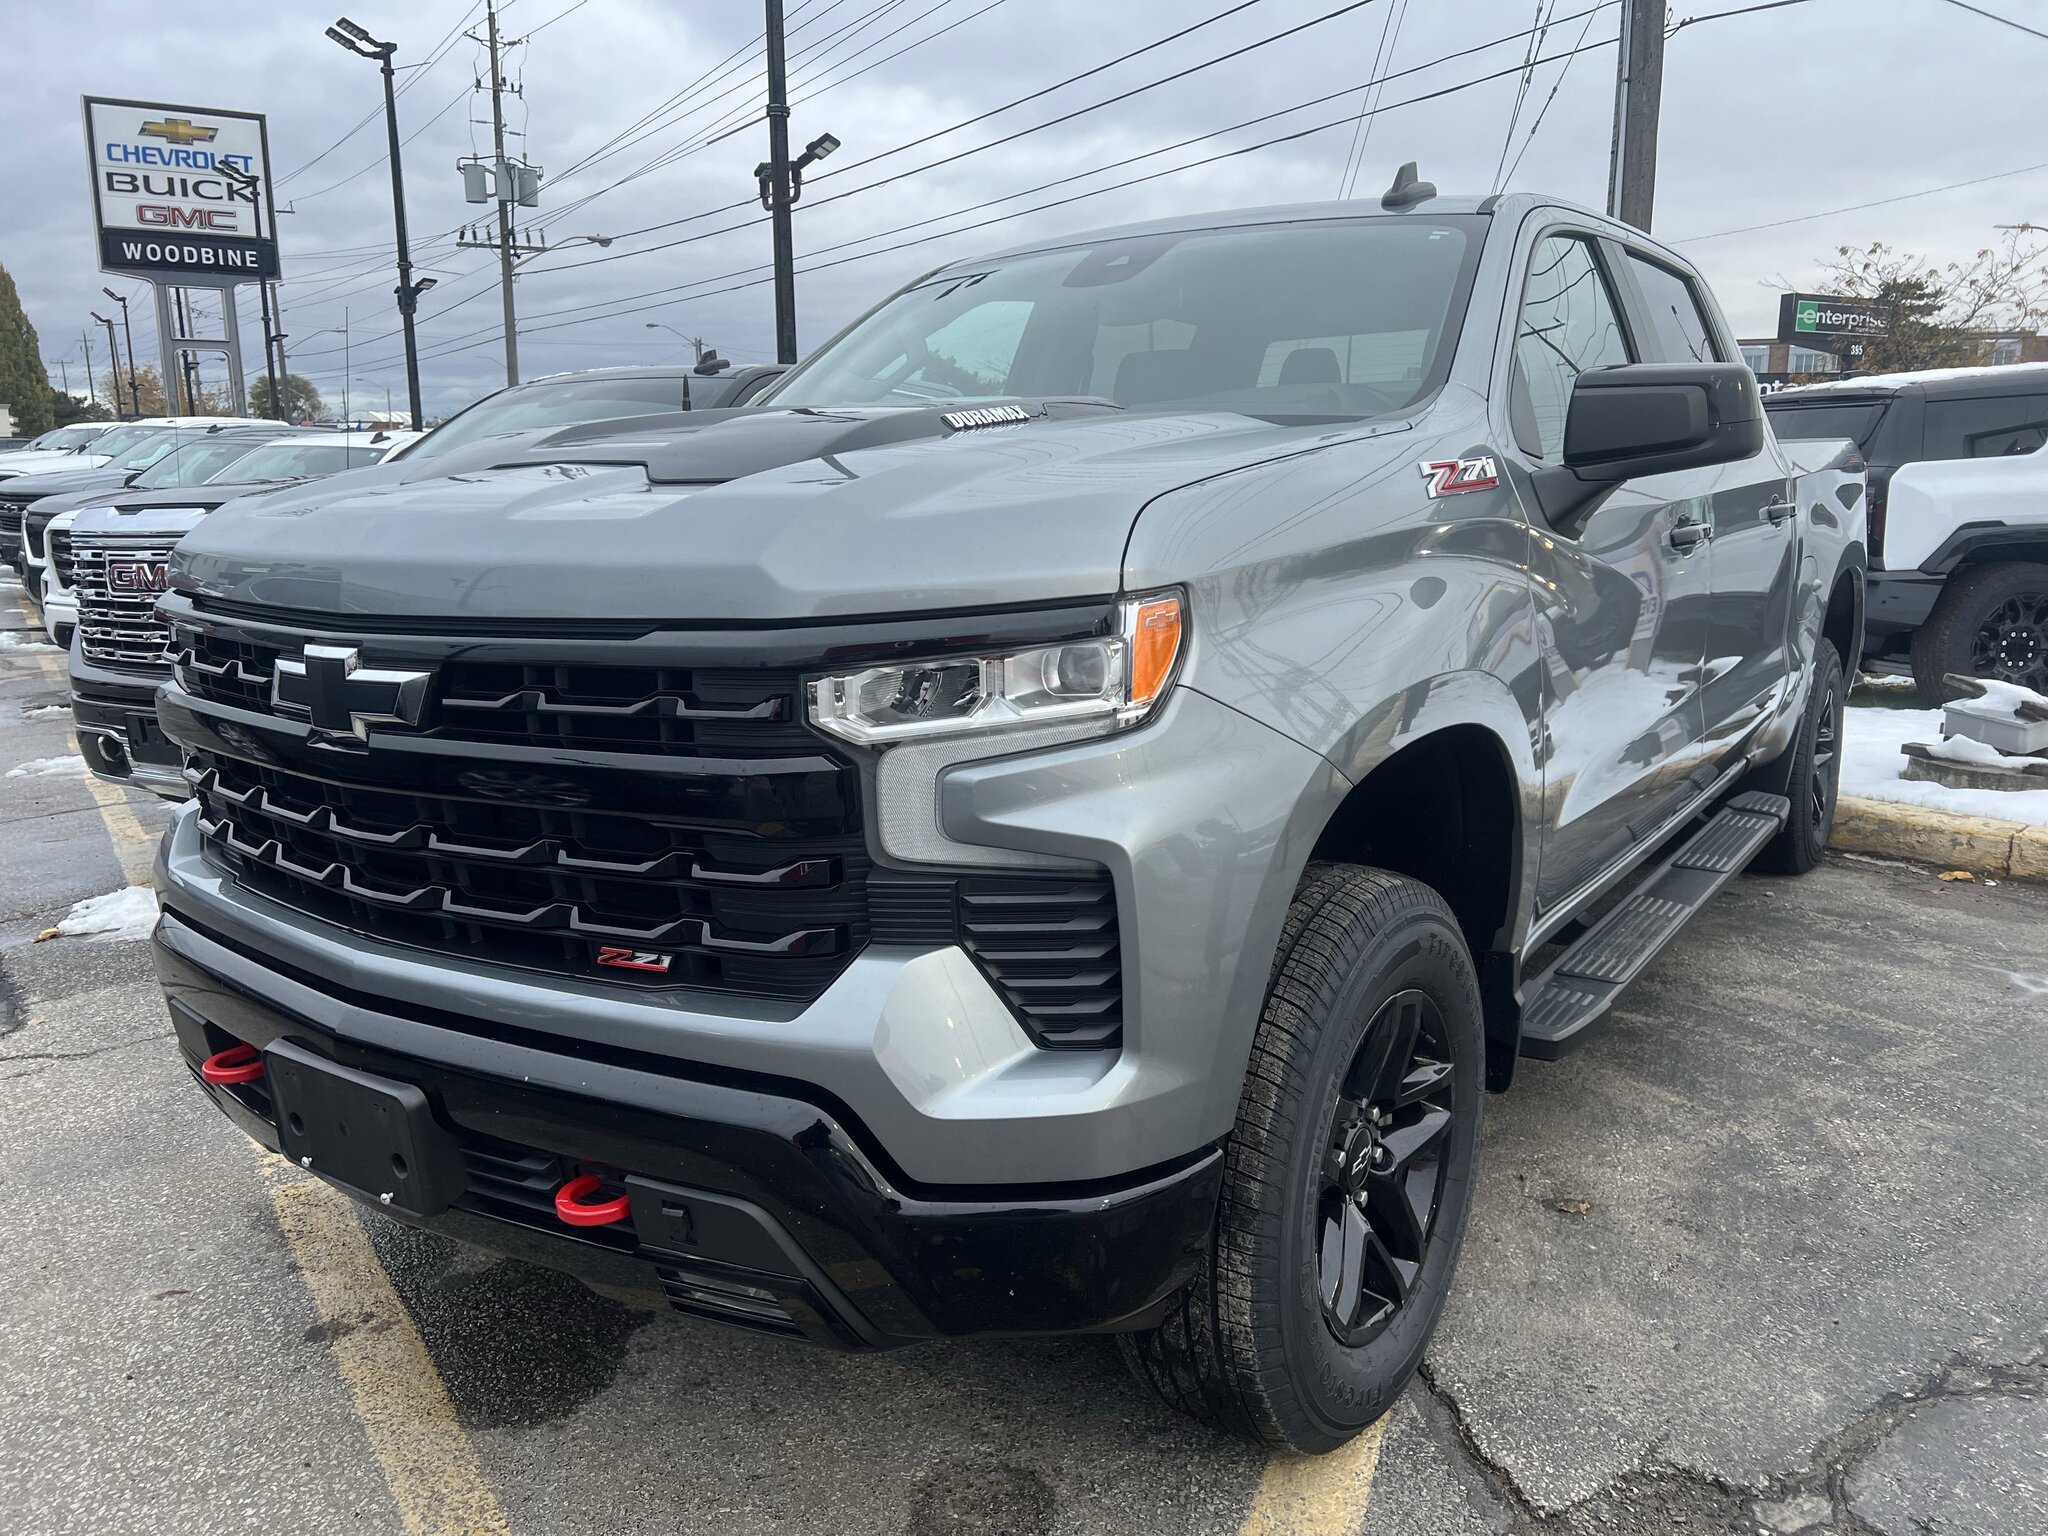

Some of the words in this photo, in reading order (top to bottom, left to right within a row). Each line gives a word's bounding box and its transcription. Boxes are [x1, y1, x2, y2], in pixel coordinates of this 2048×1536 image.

[105, 171, 255, 203] BUICK
[136, 203, 238, 232] GMC
[122, 242, 259, 268] WOODBINE
[942, 404, 1031, 431] DURAMAX
[1418, 455, 1499, 499] Z71
[110, 563, 168, 590] GM
[597, 946, 672, 973] Z71
[1307, 1319, 1384, 1409] Firestone
